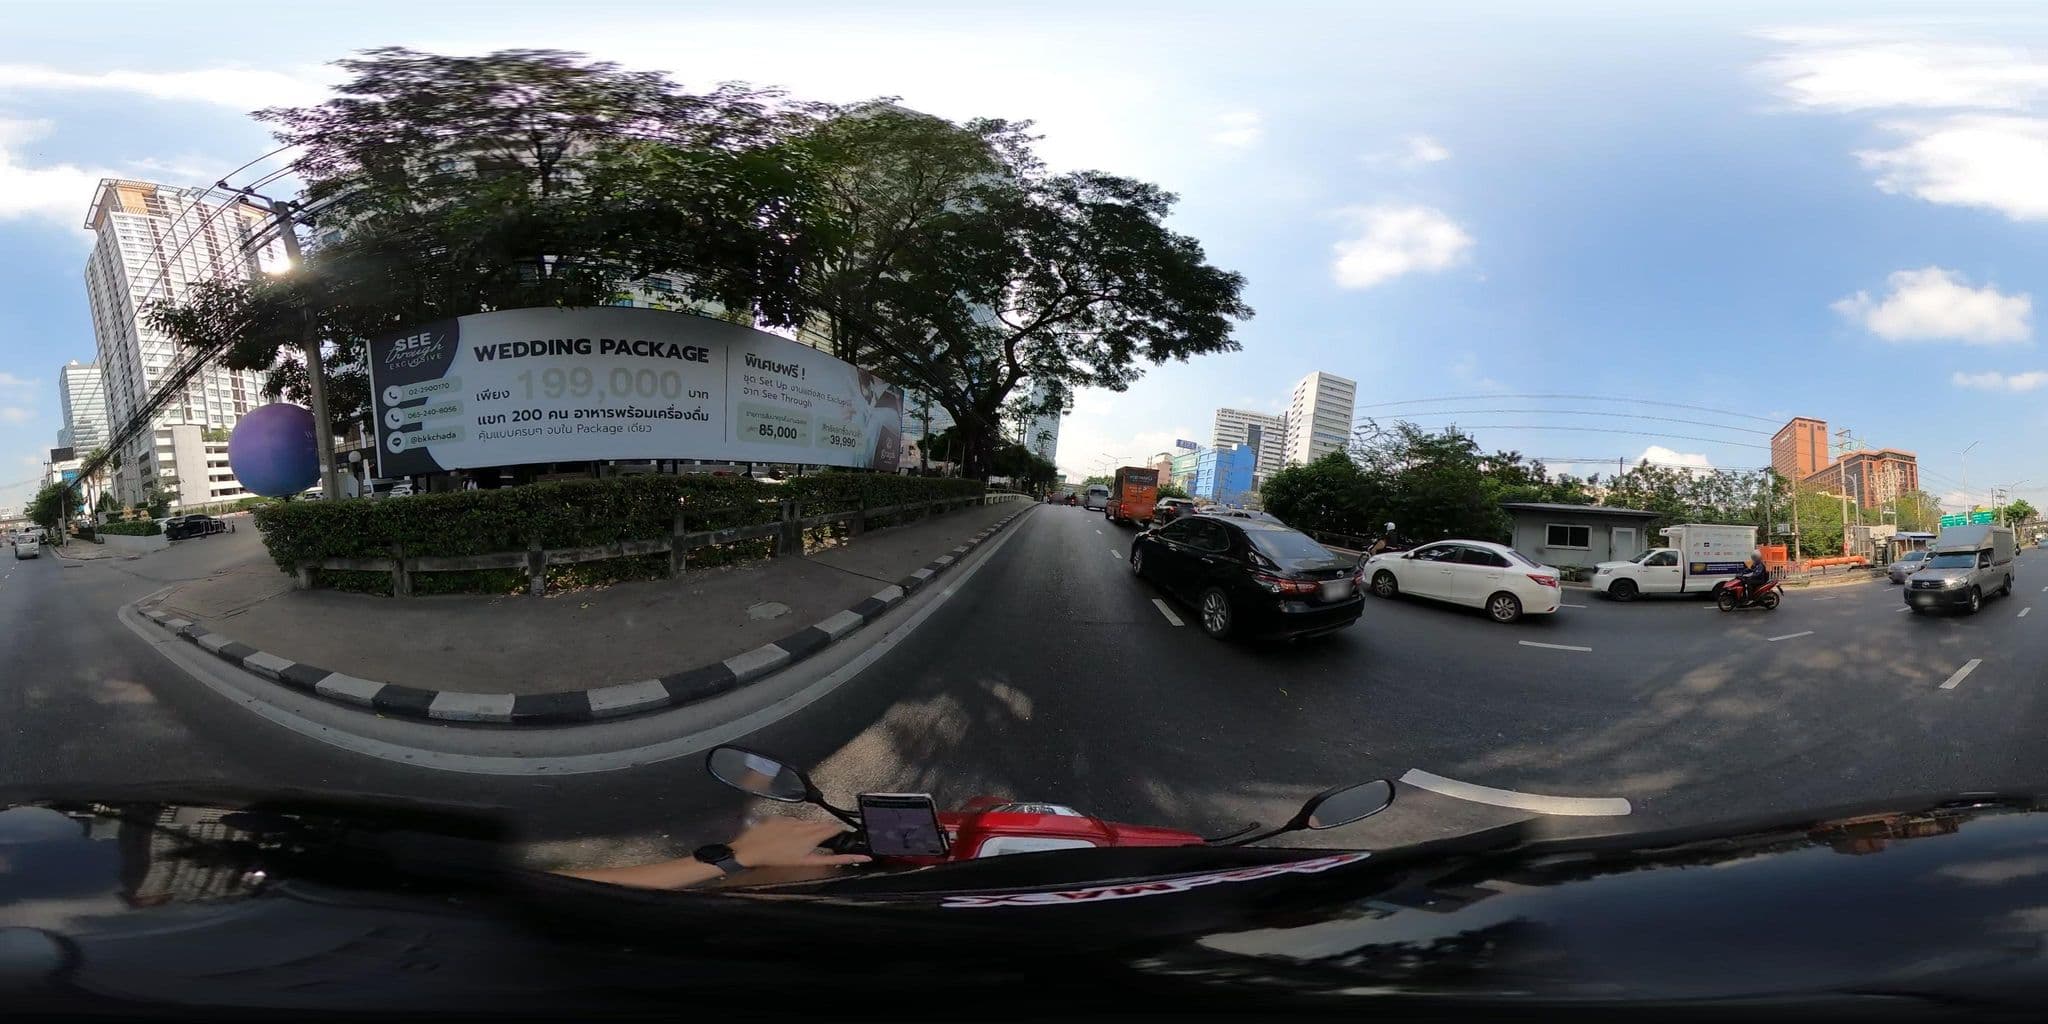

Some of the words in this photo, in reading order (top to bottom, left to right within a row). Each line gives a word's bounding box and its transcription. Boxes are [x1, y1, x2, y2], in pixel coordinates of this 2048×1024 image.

[395, 332, 431, 351] SEE
[474, 338, 592, 362] WEDDING
[600, 338, 709, 363] PACKAGE
[476, 389, 510, 401] เพียง
[518, 366, 682, 404] 199,000
[688, 389, 709, 400] บาท
[759, 377, 773, 388] Set
[776, 381, 788, 391] Up
[743, 387, 760, 397] จาก
[762, 389, 778, 400] See
[781, 393, 813, 409] Through
[478, 413, 507, 425] แขก
[512, 409, 542, 422] 200
[548, 409, 569, 420] คน
[574, 404, 709, 422] อาหารพร้อมเครื่องดื่ม
[410, 432, 457, 444] @bkkchada
[577, 422, 624, 435] Package
[759, 424, 797, 439] 85,000
